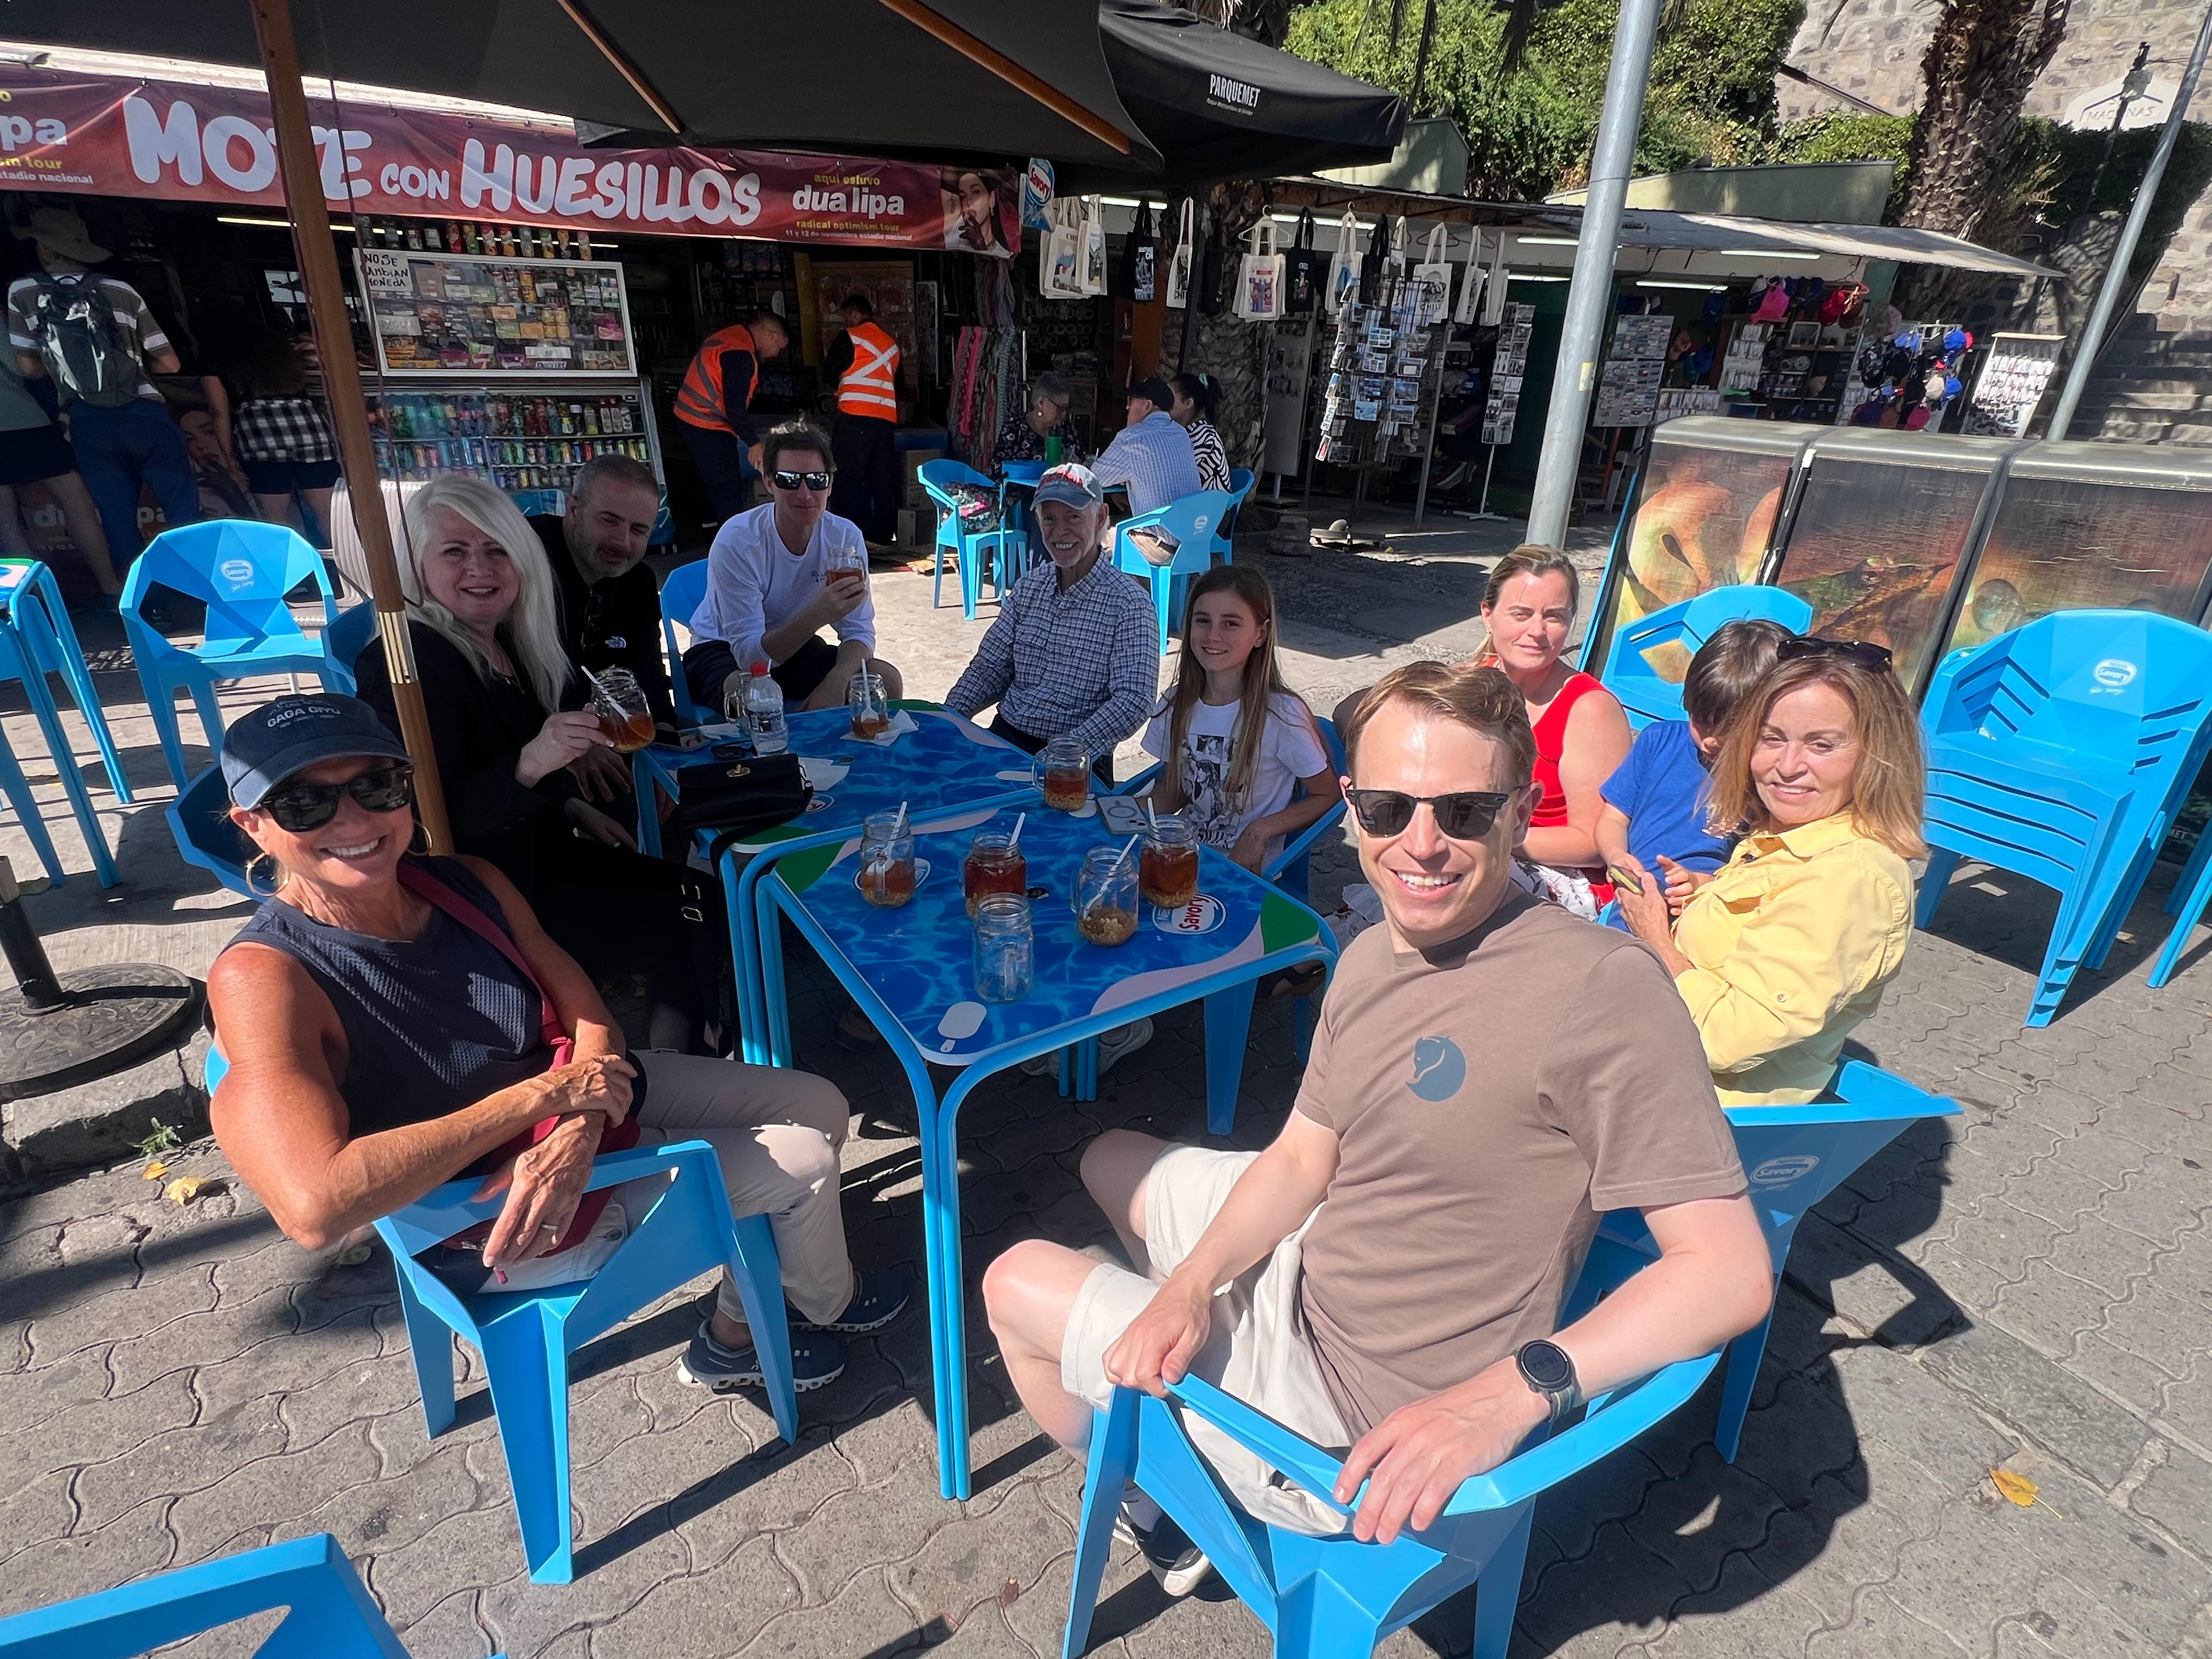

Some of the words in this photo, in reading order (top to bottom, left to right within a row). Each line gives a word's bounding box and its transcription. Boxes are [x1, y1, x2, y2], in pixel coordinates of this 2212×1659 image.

[1209, 74, 1261, 108] PARQUEMET
[25, 156, 63, 169] tour
[38, 173, 94, 184] nacional
[381, 163, 450, 200] CON
[460, 138, 761, 226] HUESILLOS
[843, 174, 881, 185] estuvo
[792, 184, 847, 213] dua
[851, 187, 904, 220] lipa
[796, 220, 831, 229] radical
[833, 221, 878, 231] optimism
[880, 223, 900, 232] tour
[1178, 896, 1210, 930] Savory
